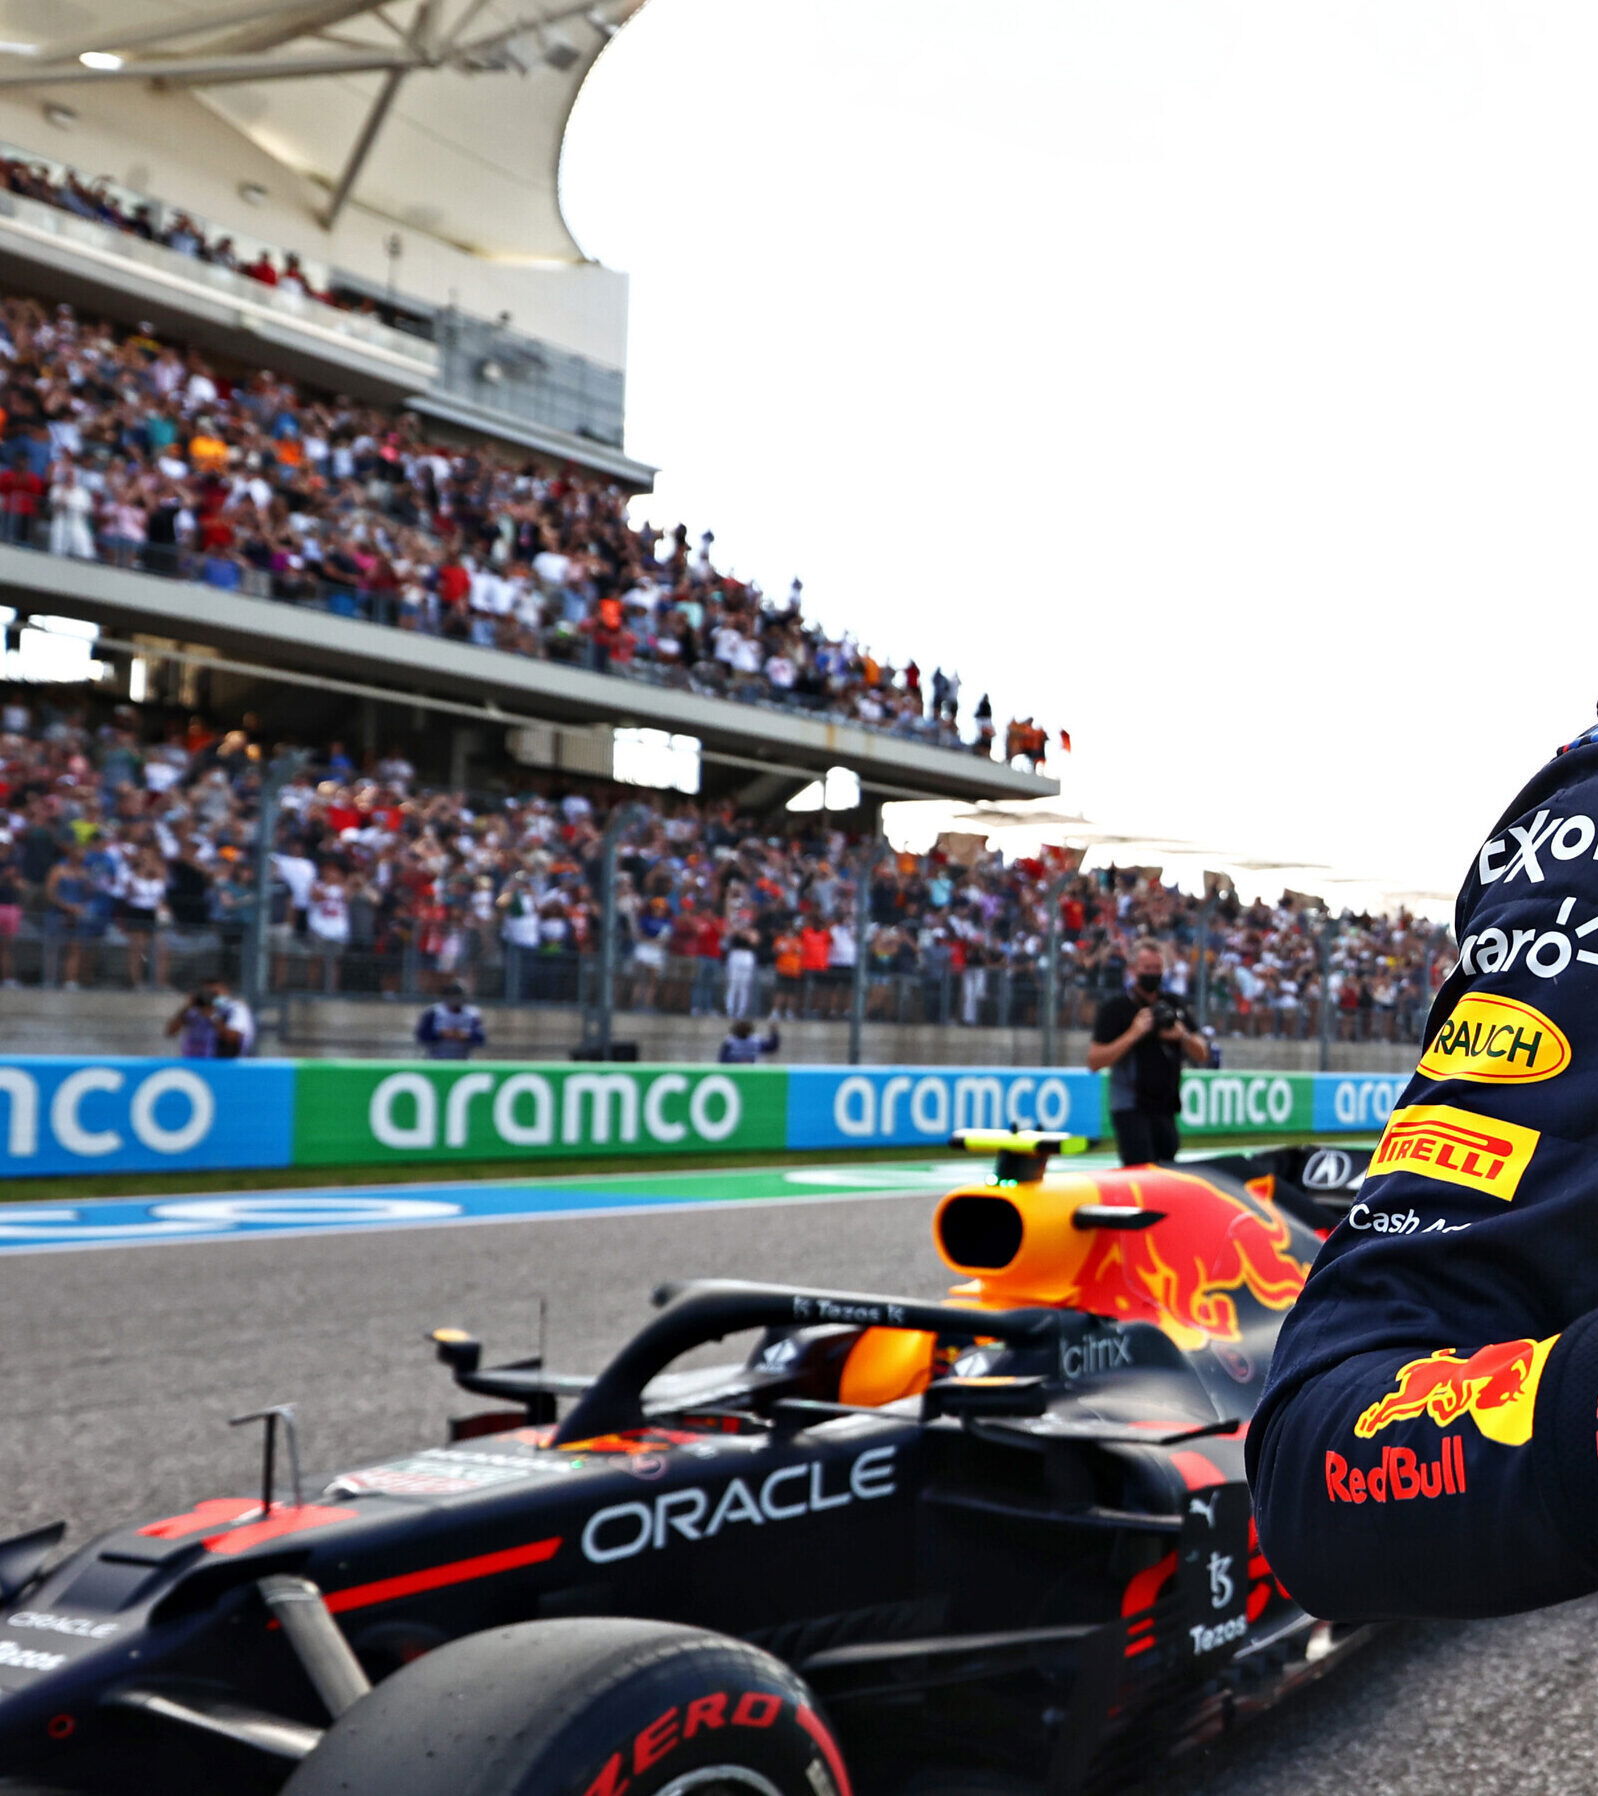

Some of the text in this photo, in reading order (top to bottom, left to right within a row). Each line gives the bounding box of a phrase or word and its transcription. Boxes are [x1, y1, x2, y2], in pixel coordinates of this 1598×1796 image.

[1433, 1018, 1543, 1068] RAUCH
[369, 1071, 742, 1150] aramco
[834, 1074, 1071, 1138] aramco
[1181, 1078, 1293, 1127] amco
[1335, 1080, 1410, 1124] ara
[1377, 1120, 1514, 1181] PIRELLI
[1348, 1203, 1421, 1235] Cash
[581, 1445, 896, 1563] ORACLE
[1189, 1614, 1248, 1656] Tezos
